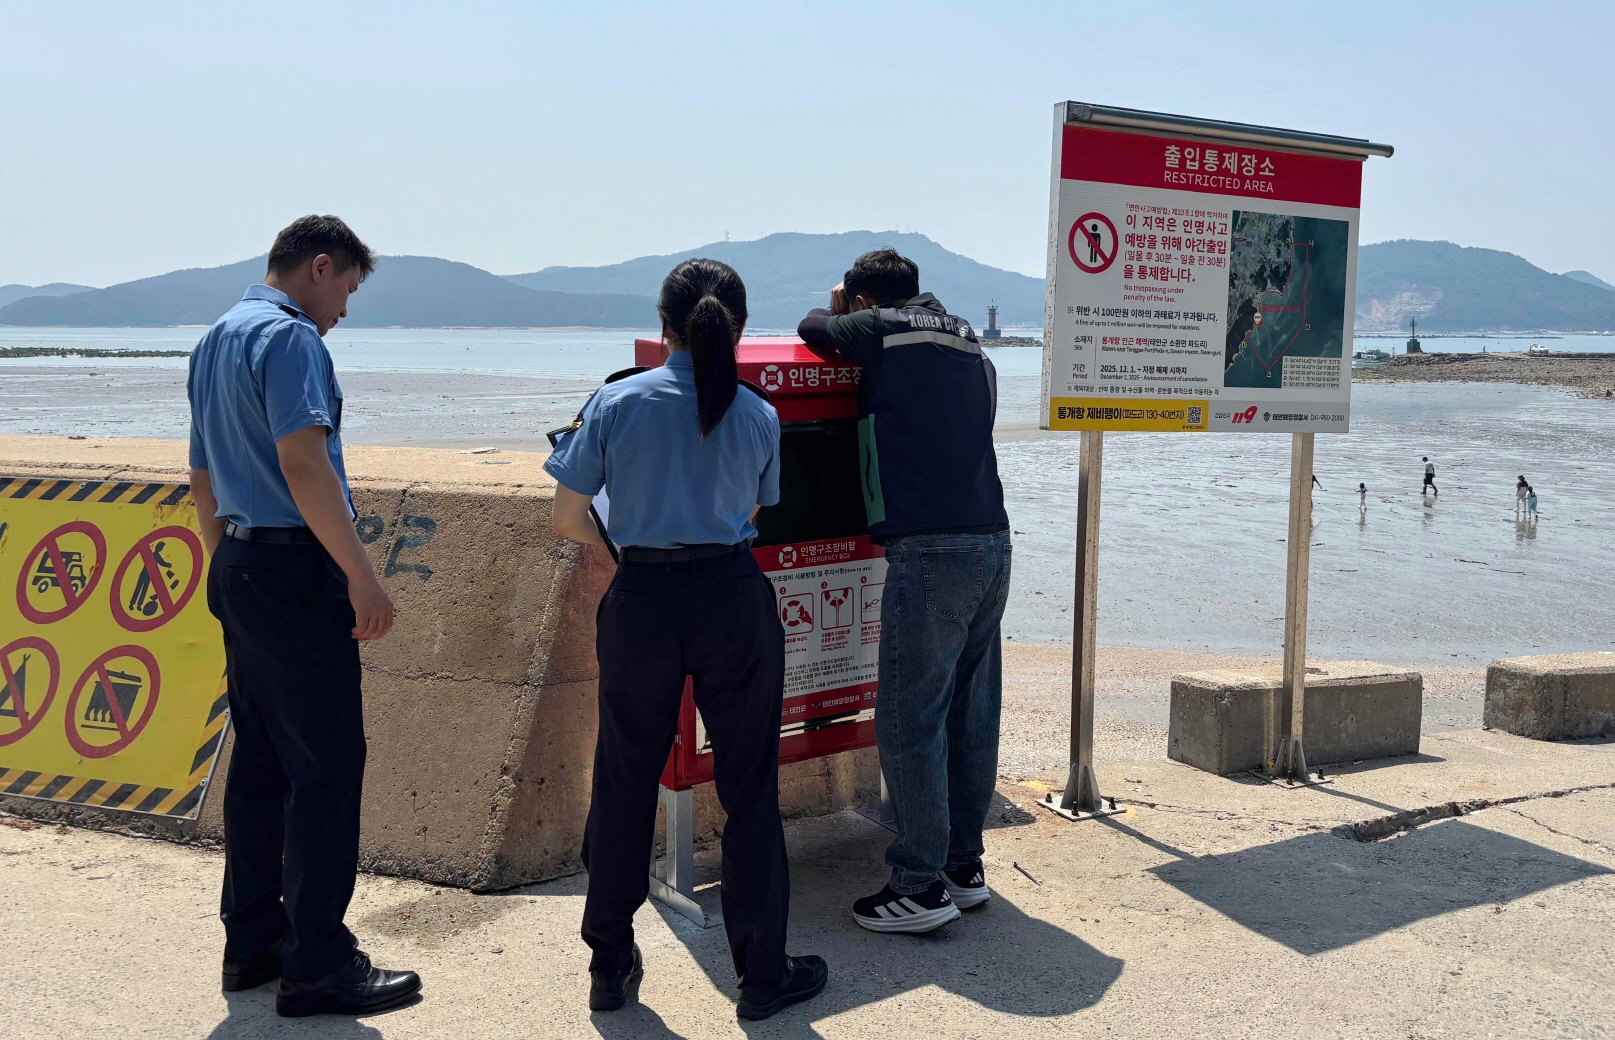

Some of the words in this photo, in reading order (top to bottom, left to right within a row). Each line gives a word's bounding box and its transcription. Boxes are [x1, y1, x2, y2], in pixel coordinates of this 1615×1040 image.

[1164, 145, 1276, 176] 출입통제장소
[1164, 171, 1240, 190] RESTRICTED
[1244, 180, 1274, 193] AREA
[1126, 214, 1136, 229] 이
[1142, 216, 1177, 232] 지역은
[1183, 219, 1228, 236] 인명사고
[1124, 233, 1158, 250] 예방을
[1161, 236, 1182, 251] 위해
[1185, 237, 1227, 254] 야간출입
[1124, 250, 1144, 263] (일몰
[1145, 251, 1152, 262] 후
[1155, 252, 1172, 264] 30분
[1180, 254, 1195, 266] 일출
[1197, 256, 1205, 266] 전
[1207, 257, 1226, 268] 30분)
[1123, 264, 1134, 280] 을
[1137, 265, 1196, 283] 통제합니다.
[1134, 285, 1166, 294] trespassing
[1124, 294, 1145, 302] penalty
[909, 314, 942, 329] KOREA
[1076, 306, 1090, 316] 위반
[1092, 306, 1100, 316] 시
[1101, 308, 1129, 318] 100만원
[1130, 308, 1152, 319] 이하의
[1154, 310, 1181, 320] 과태료가
[1182, 311, 1218, 322] 부과됩니다.
[1074, 336, 1092, 344] 소재지
[1072, 364, 1085, 372] 기간
[1142, 366, 1154, 374] 지정
[1170, 367, 1187, 375] 시까지
[1057, 406, 1085, 420] 통개항
[1232, 406, 1258, 424] 119
[1310, 413, 1345, 421] 041-950-2000
[800, 541, 856, 556] 인명구조장비함
[805, 554, 839, 564] EMERGENCY
